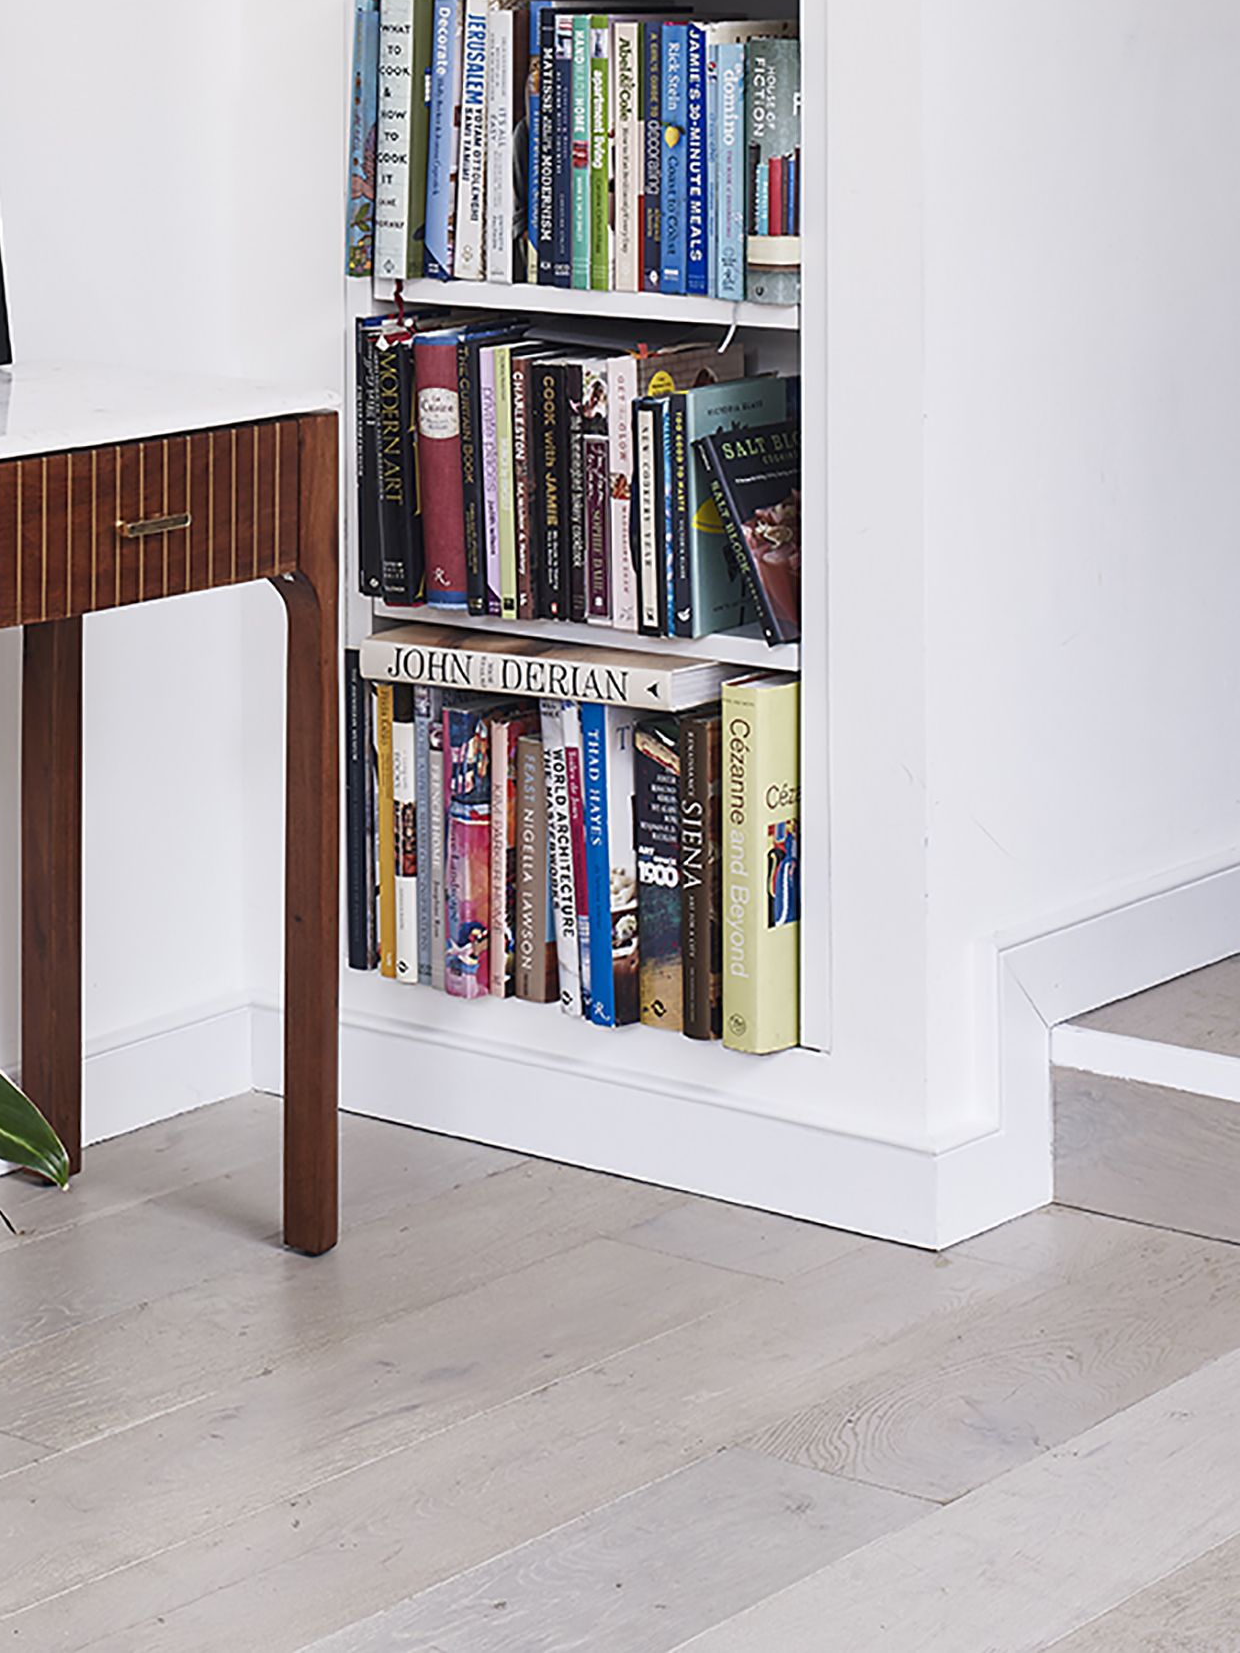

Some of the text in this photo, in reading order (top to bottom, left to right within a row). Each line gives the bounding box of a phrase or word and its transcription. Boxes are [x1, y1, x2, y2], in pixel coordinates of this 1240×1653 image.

[387, 45, 402, 55] TO
[435, 5, 452, 75] Decorate
[465, 13, 487, 104] JERUSALEM
[618, 36, 633, 71] Abel
[378, 65, 411, 76] COOK
[543, 47, 553, 112] MATISSE
[667, 41, 680, 110] Rick Stein
[753, 56, 765, 136] FICTION
[764, 65, 776, 130] HOUSE OF
[380, 110, 406, 120] HOW
[592, 69, 606, 133] apartment
[618, 89, 633, 121] Cole
[722, 68, 738, 145] domino
[376, 152, 408, 164] COOK
[384, 131, 400, 141] TO
[461, 106, 474, 181] SAMI TAMIMI
[592, 135, 606, 169] living
[645, 119, 661, 195] decorating
[688, 28, 702, 261] JAMIE'S 30-MINUTE MEALS
[381, 174, 394, 185] IT
[470, 107, 483, 221] YOTAM OTTOLENGHI
[666, 155, 679, 195] Coast
[540, 154, 552, 240] MODERNISM
[667, 198, 679, 212] to
[379, 351, 400, 454] MODERN
[458, 344, 474, 484] THE CURTAIN BOOK
[512, 371, 525, 460] CHARLESTON
[543, 375, 555, 425] COOK
[674, 411, 683, 431] TOO
[481, 386, 499, 492] private places
[544, 430, 556, 467] with
[675, 434, 684, 462] GOOD
[721, 437, 767, 461] SALT
[384, 459, 403, 506] ART
[546, 472, 558, 525] JAMIE
[641, 426, 653, 568] NEW COOKERY YEAR
[676, 465, 684, 478] TO
[676, 481, 685, 512] WASTE
[571, 493, 583, 522] bakery
[592, 509, 603, 552] SOPHIE
[572, 524, 583, 567] cookbook
[592, 557, 603, 594] DAHL
[387, 647, 473, 684] JOHN
[501, 659, 629, 702] DERIAN
[587, 728, 602, 847] THAD HAYES
[431, 763, 441, 868] FRENCH HOME
[553, 748, 575, 937] WORLD ARCHITECTURE
[492, 783, 503, 934] KIM PARKER HOME
[521, 752, 536, 969] FEAST NIGELLA LAWSON
[681, 800, 703, 890] SIENA
[726, 717, 752, 978] Cézanne and Beyond
[638, 860, 679, 888] 1900
